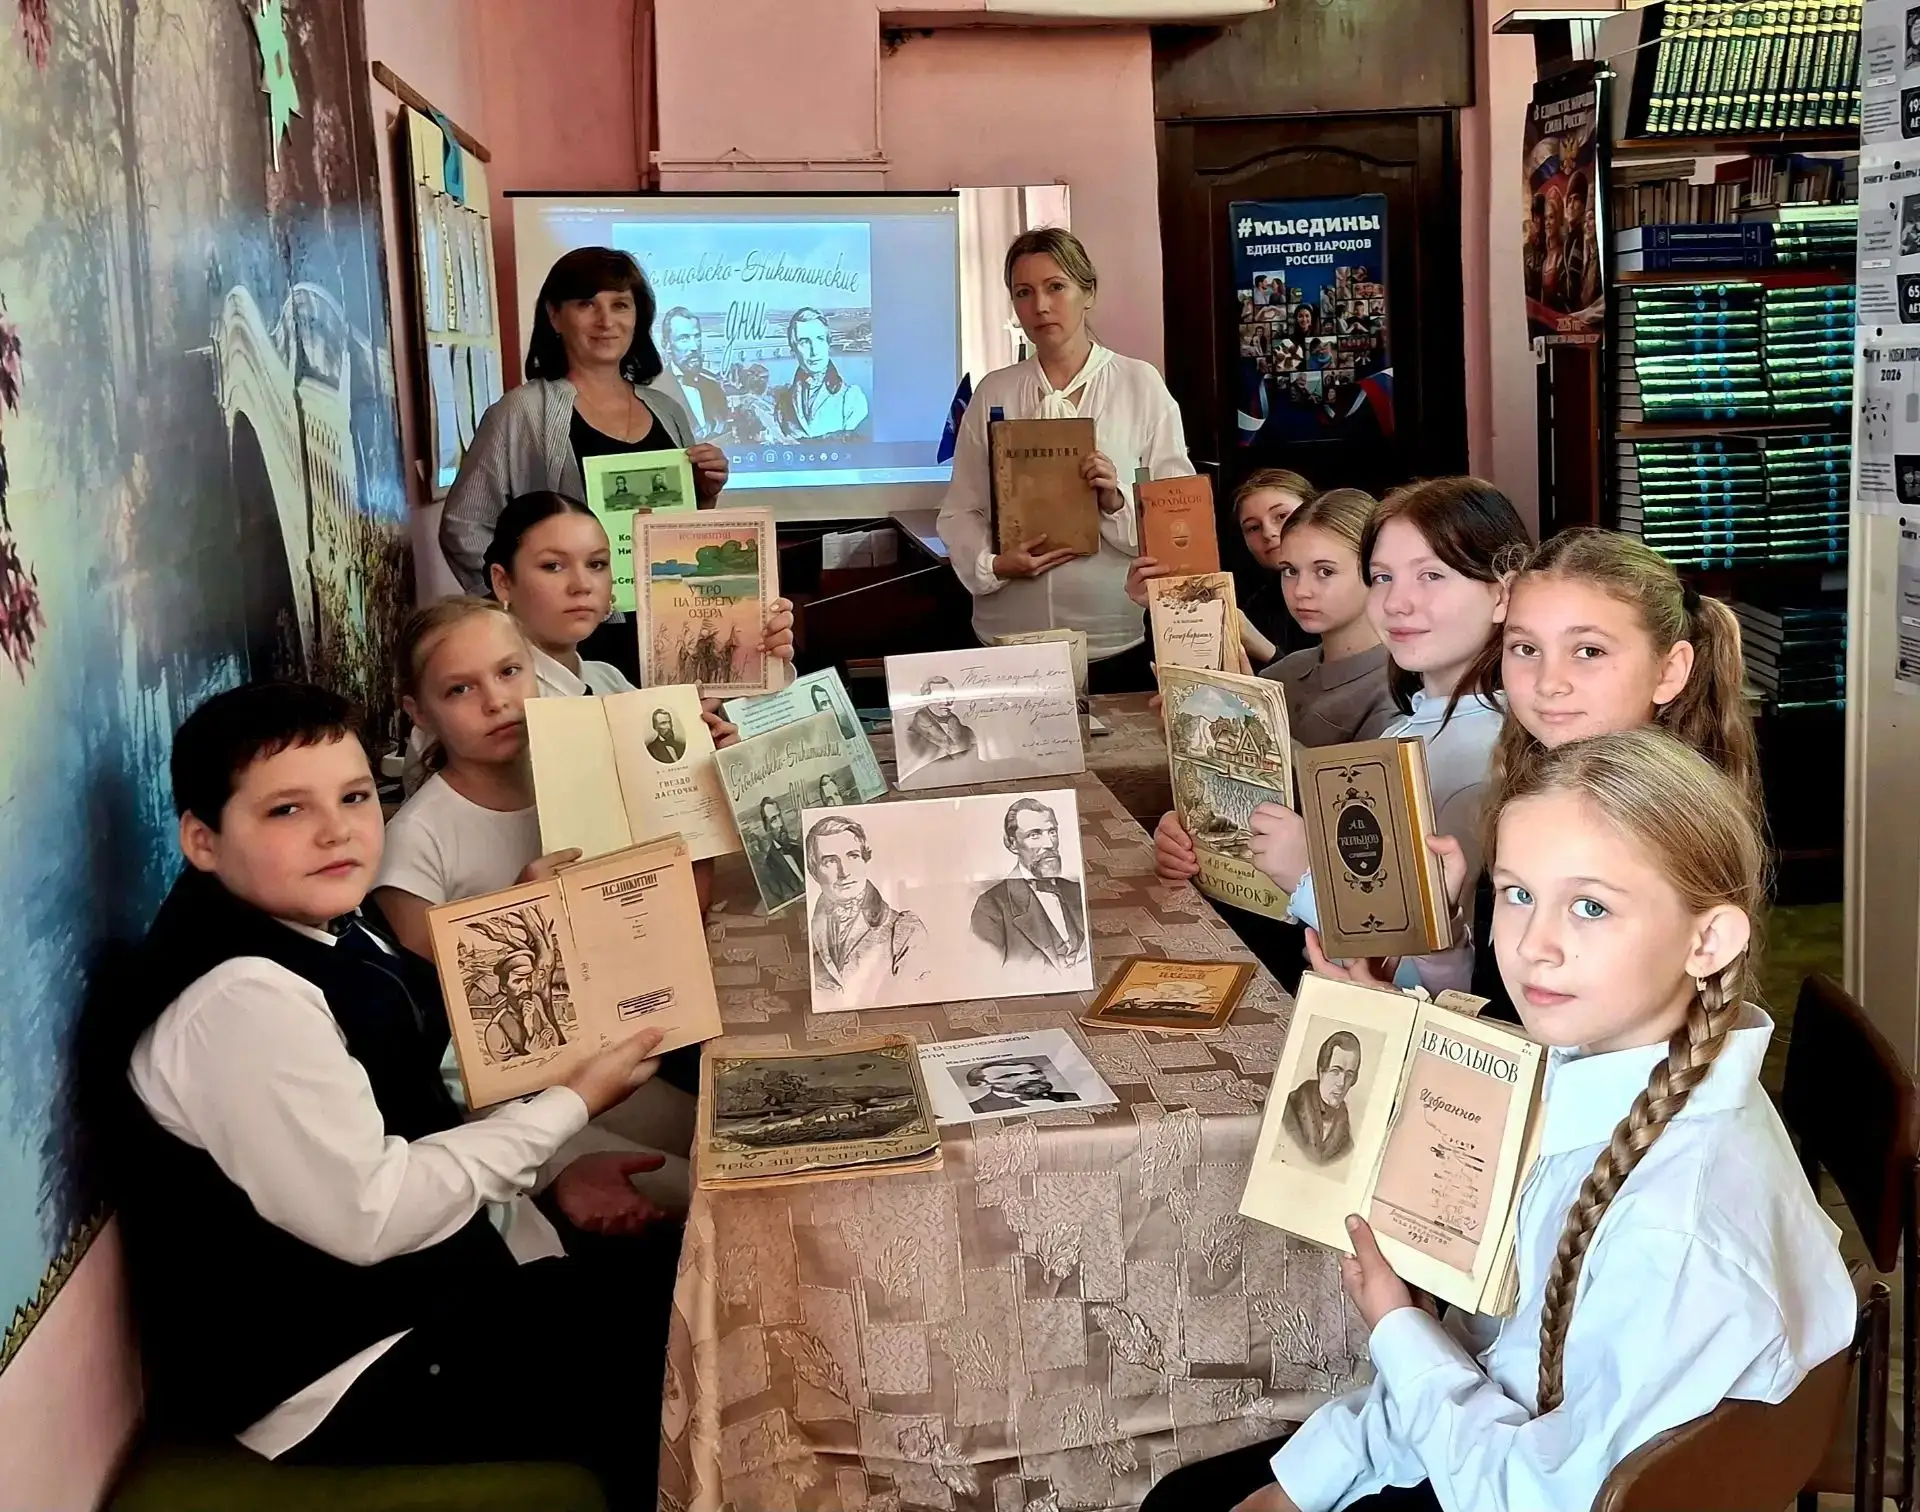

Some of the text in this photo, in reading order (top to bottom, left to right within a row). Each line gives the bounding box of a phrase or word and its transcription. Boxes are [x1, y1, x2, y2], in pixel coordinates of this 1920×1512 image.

[1237, 214, 1381, 238] #мыедины
[1246, 238, 1372, 256] ЕДИНСТВО НАРОДОВ
[1285, 253, 1334, 266] РОССИИ
[1880, 369, 1901, 381] 2026
[1151, 495, 1202, 509] КОЛЬЦОВ
[688, 584, 722, 597] УТРО
[673, 596, 737, 608] НА БЕРЕГУ
[688, 608, 724, 619] ОЗЕРА
[659, 776, 691, 788] ГНЕЗДО
[655, 785, 699, 800] ЛАСТОЧКИ
[1205, 872, 1262, 903] ХУТОРОК
[933, 1034, 1031, 1052] Воронежской
[1439, 1037, 1519, 1083] КОЛЬЦОВ
[1419, 1087, 1482, 1124] Избранное
